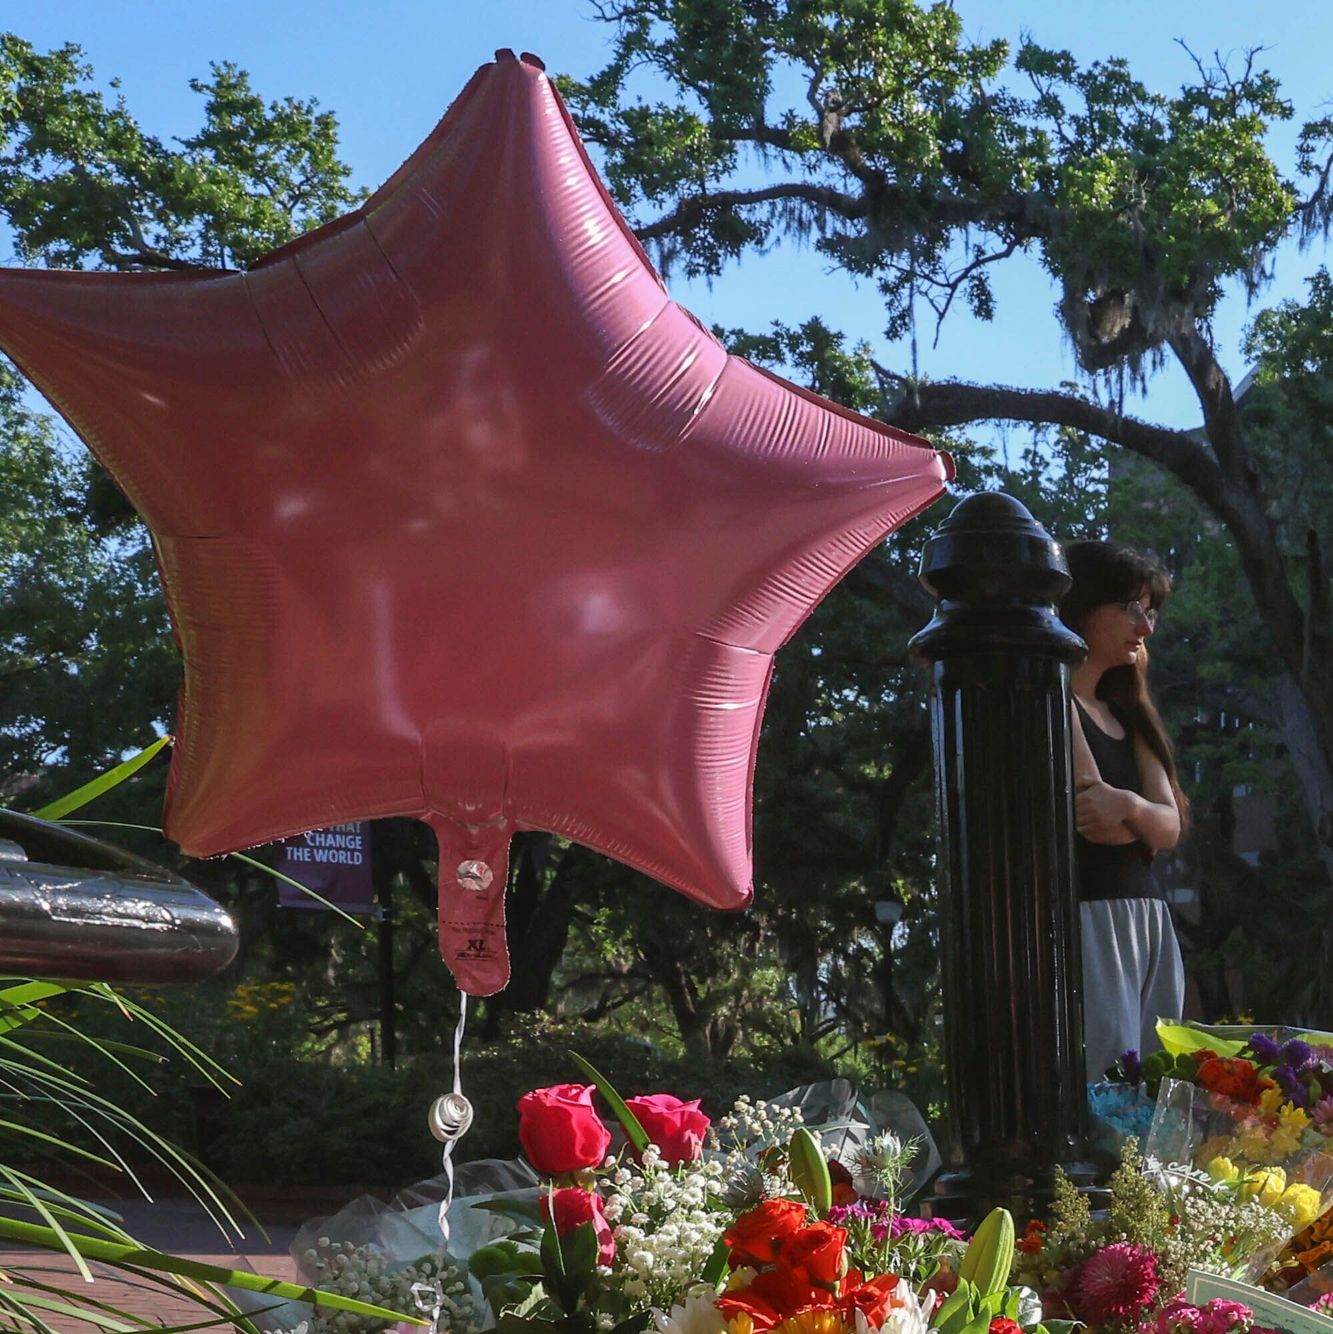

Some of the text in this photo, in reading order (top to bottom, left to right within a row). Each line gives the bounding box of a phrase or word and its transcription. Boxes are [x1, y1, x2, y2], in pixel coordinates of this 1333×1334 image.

[306, 833, 363, 850] CHANGE
[286, 847, 363, 865] THE WORLD
